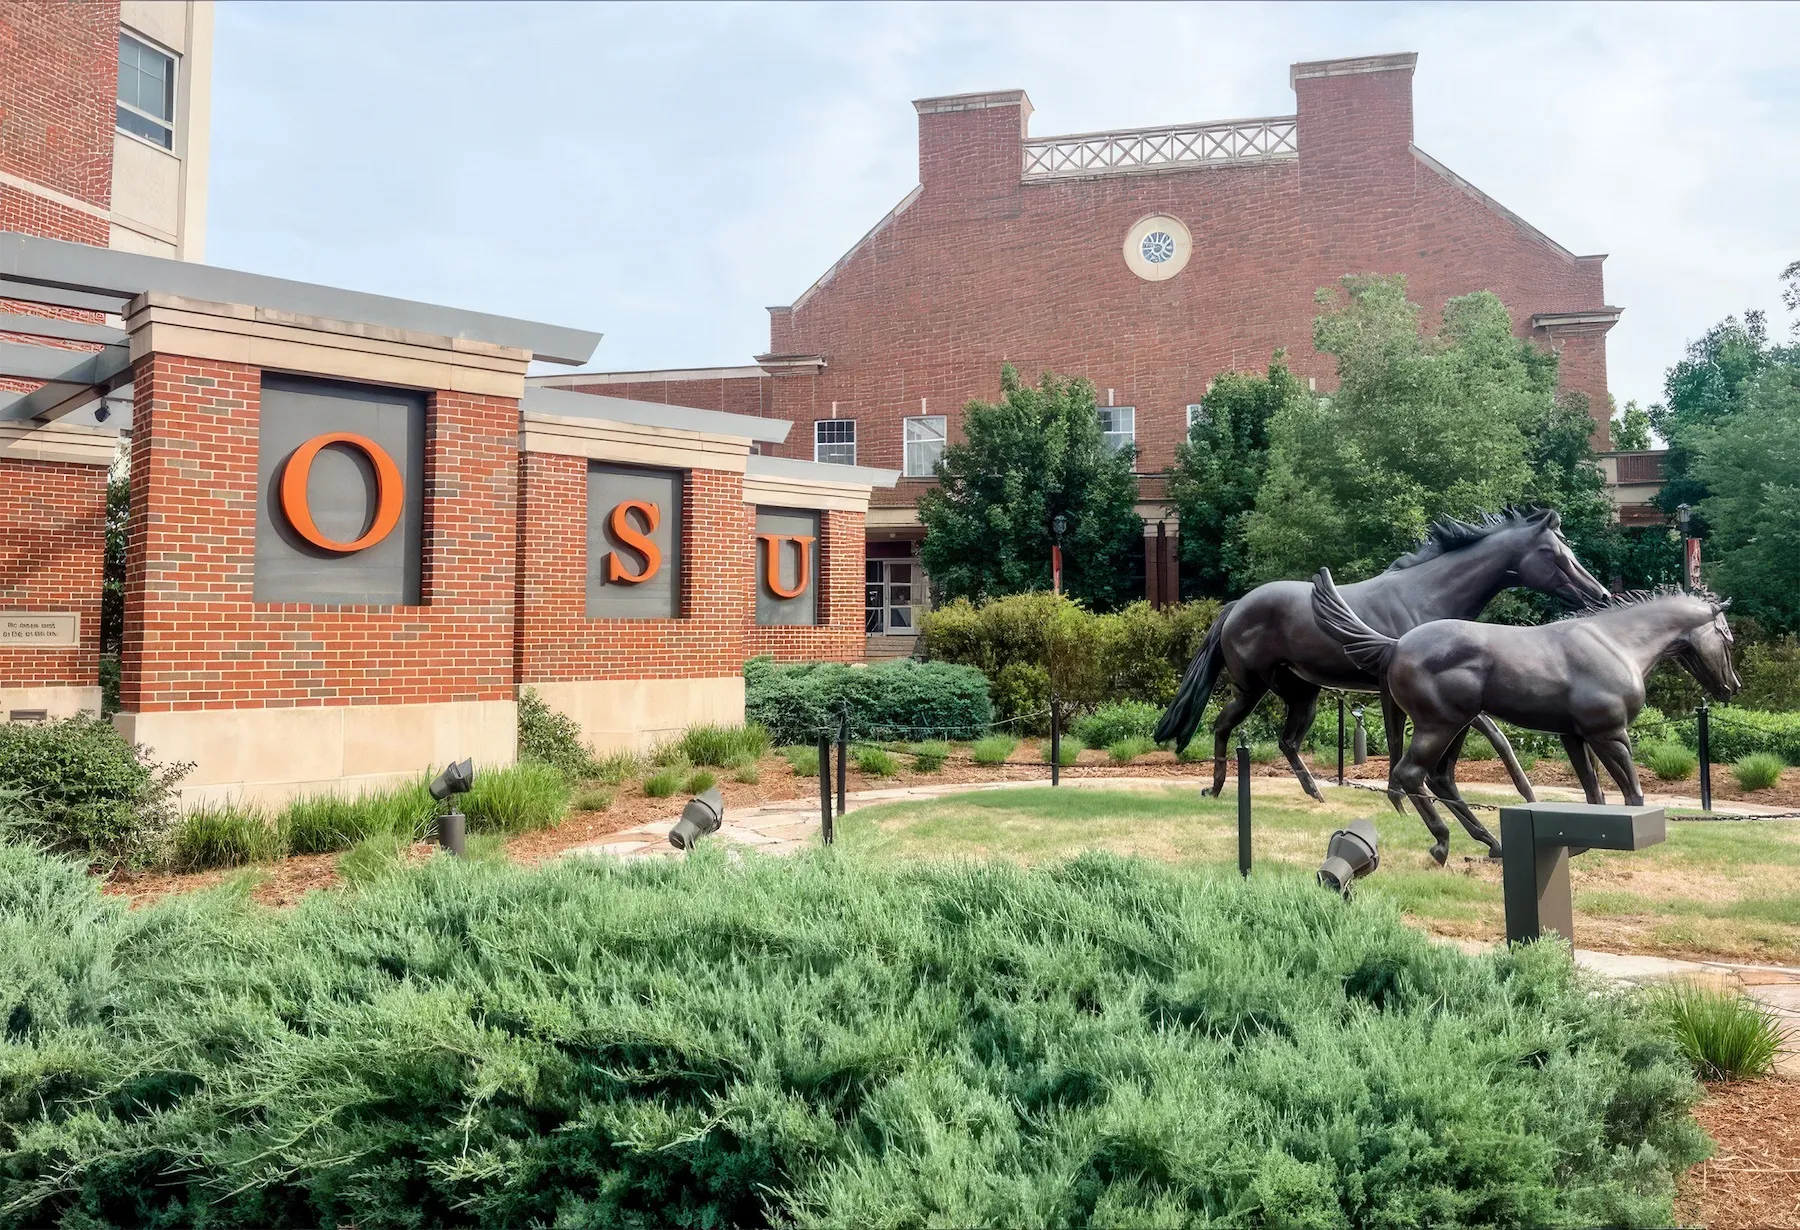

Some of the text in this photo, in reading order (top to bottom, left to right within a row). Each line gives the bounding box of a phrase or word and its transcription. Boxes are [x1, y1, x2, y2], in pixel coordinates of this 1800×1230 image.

[281, 432, 817, 598] O S U
